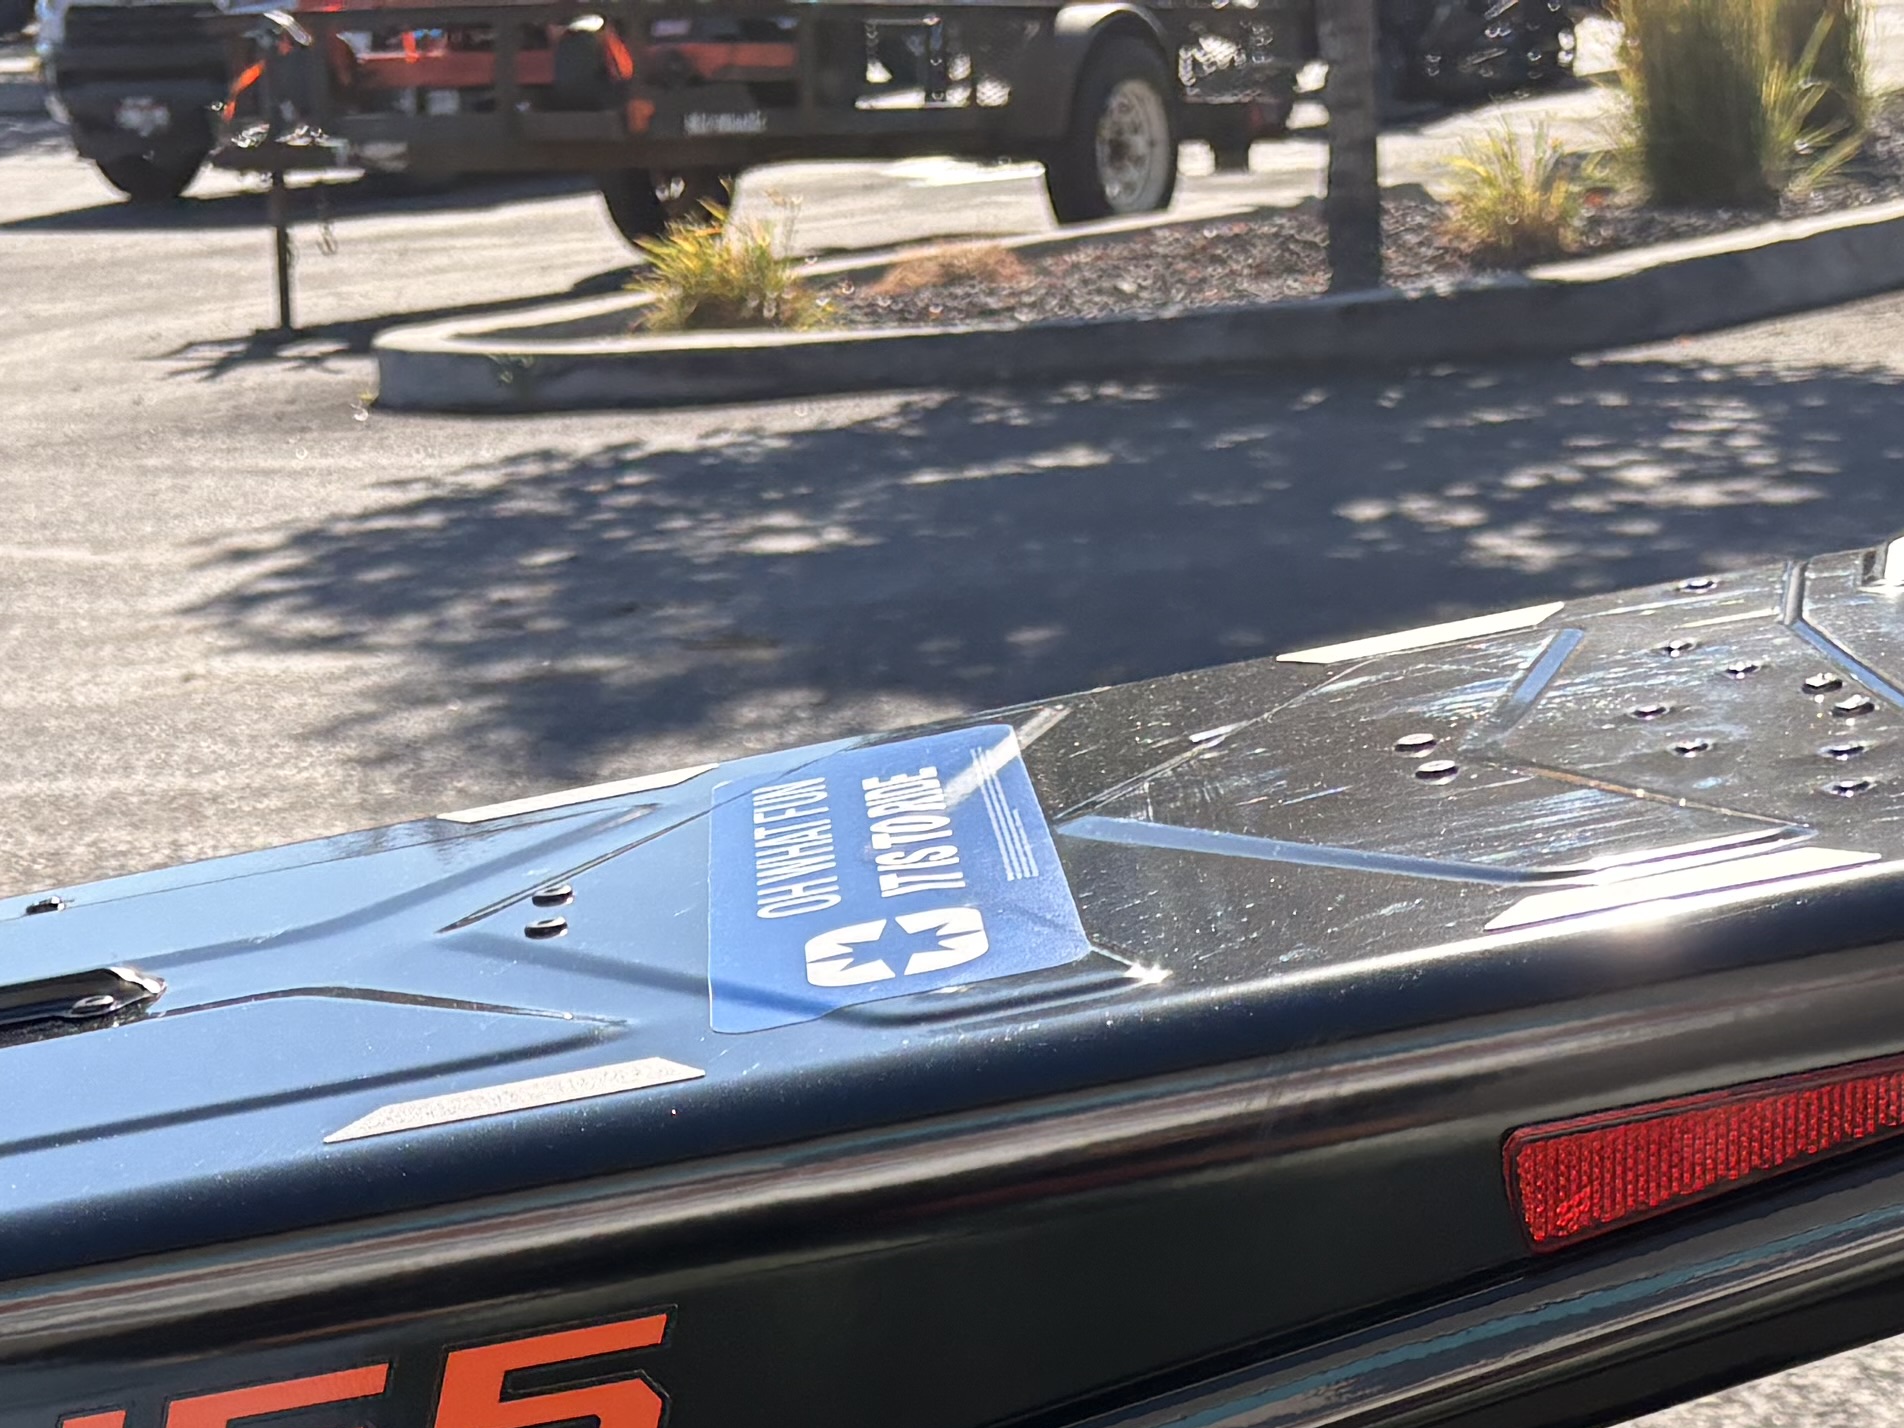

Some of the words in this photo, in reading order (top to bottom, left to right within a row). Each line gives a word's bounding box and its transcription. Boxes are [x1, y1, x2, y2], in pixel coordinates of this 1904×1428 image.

[751, 776, 830, 825] FUN
[861, 765, 947, 819] RIDE
[754, 818, 837, 887] WHAT
[869, 814, 954, 850] TO
[874, 844, 961, 872] IS
[756, 875, 842, 919] OH
[879, 871, 966, 898] IT
